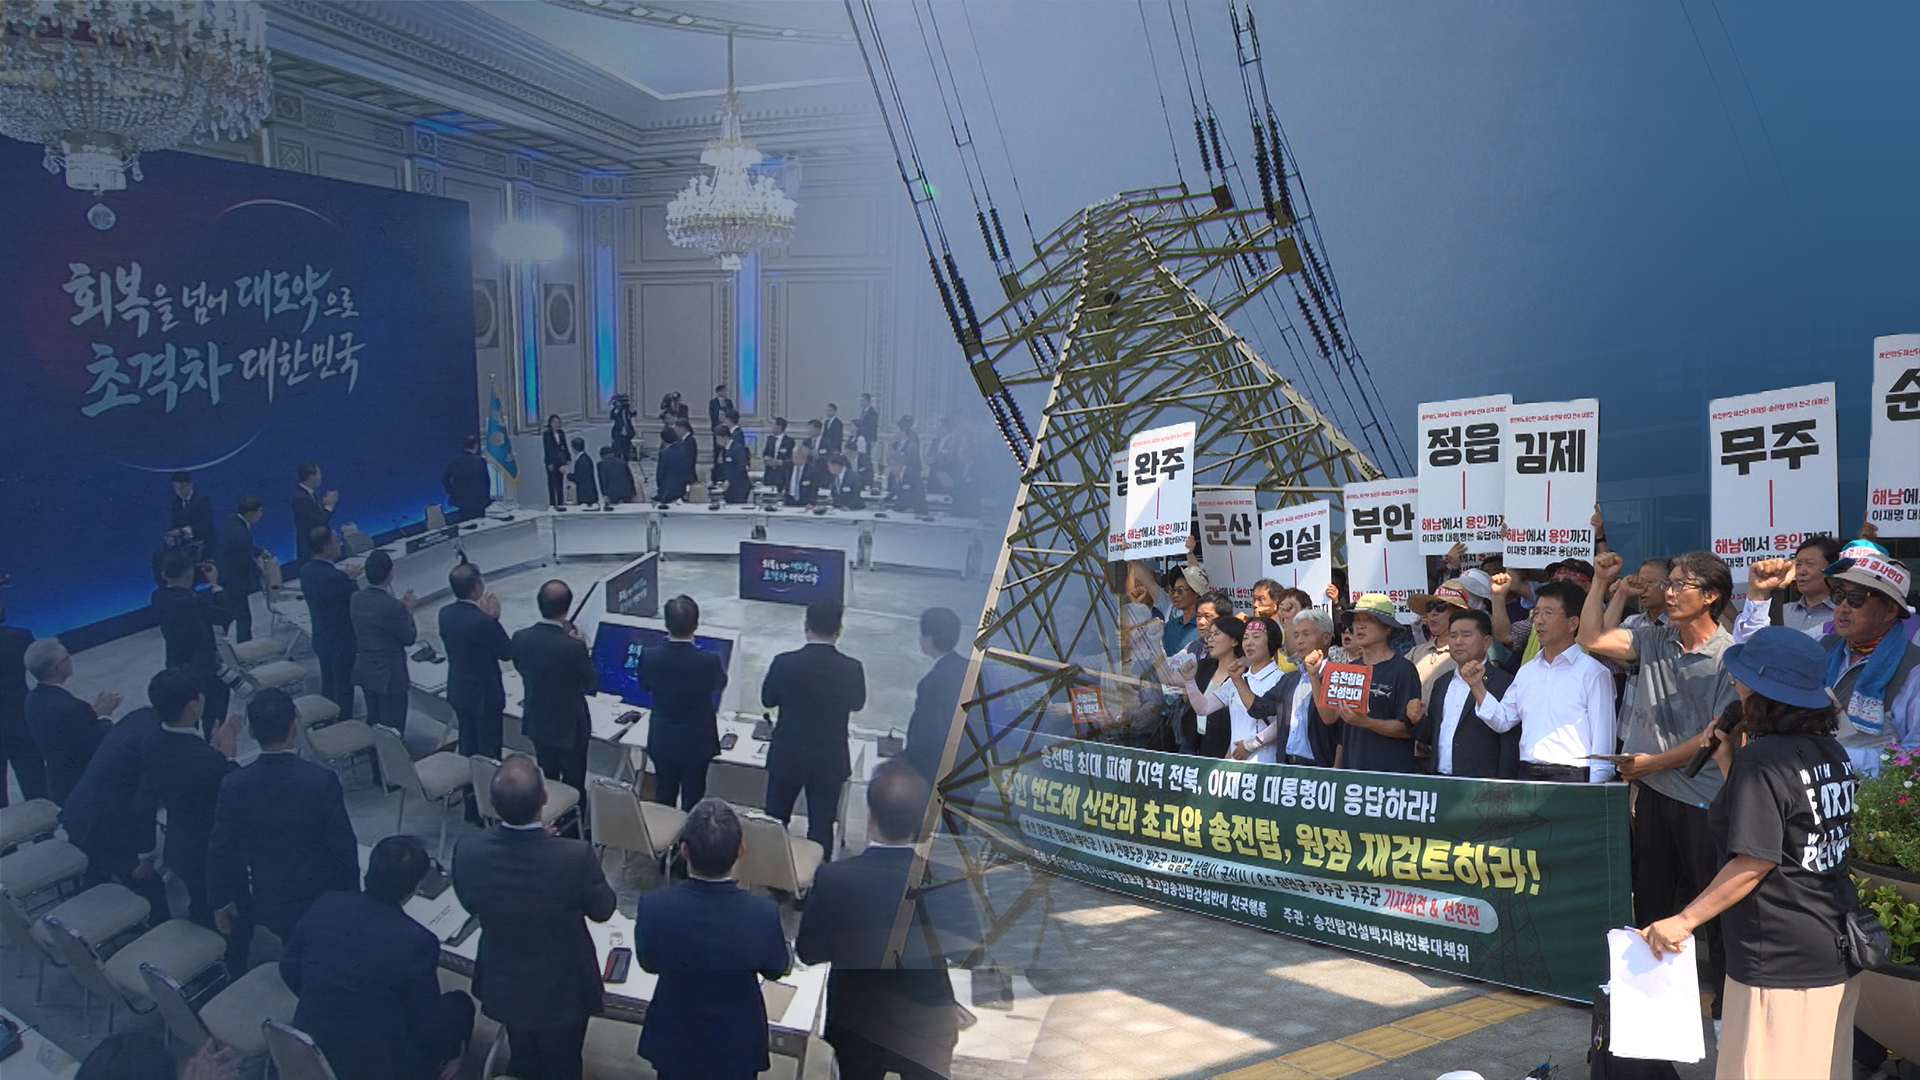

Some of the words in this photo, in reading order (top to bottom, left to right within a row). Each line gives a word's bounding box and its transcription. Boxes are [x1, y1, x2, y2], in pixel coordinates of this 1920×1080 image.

[62, 261, 180, 337] 회복을
[182, 281, 228, 326] 넘어
[234, 263, 360, 334] 대도약으로
[81, 340, 234, 418] 초격차
[238, 331, 366, 404] 대한민국
[1427, 422, 1500, 467] 정읍
[1515, 429, 1586, 474] 김제
[1720, 418, 1819, 475] 무주
[1134, 446, 1185, 485] 완주
[1872, 488, 1920, 505] 해남에
[1872, 509, 1904, 521] 이재명
[1907, 509, 1920, 520] 대
[1127, 525, 1156, 540] 해남에서
[1157, 521, 1188, 536] 용인까지
[1204, 513, 1251, 546] 군산
[1352, 503, 1415, 543] 부안
[1421, 516, 1463, 531] 해남에서
[1506, 529, 1547, 543] 해남에서
[1548, 529, 1591, 544] 용인까지
[1269, 524, 1322, 567] 임실
[1506, 545, 1527, 555] 이재명
[1715, 535, 1770, 554] 해남에서
[1327, 684, 1363, 701] 건설반대
[1041, 745, 1074, 772] 송전탑
[1077, 751, 1102, 778] 최대
[1105, 755, 1132, 783] 피해
[1135, 760, 1163, 789] 지역
[1168, 764, 1202, 795] 전북,
[1207, 768, 1259, 803] 이재명
[1262, 776, 1338, 813] 대통령이
[1343, 783, 1438, 824] 응답하라!
[1799, 763, 1832, 785] WITH
[1030, 776, 1081, 821] 반도체
[1081, 789, 1138, 835] 산단과
[1141, 799, 1204, 849] 초고압
[1208, 811, 1292, 865] 송전탑,
[1295, 823, 1353, 873] 원점
[1356, 832, 1542, 896] 재검토하라!
[1230, 894, 1268, 918] 전국행동
[1382, 888, 1426, 917] 기자회견
[1429, 898, 1439, 919] &
[1442, 900, 1481, 927] 선전전
[1283, 907, 1304, 926] 주관
[1313, 913, 1470, 964] 송전탑건설백지화전북대책위
